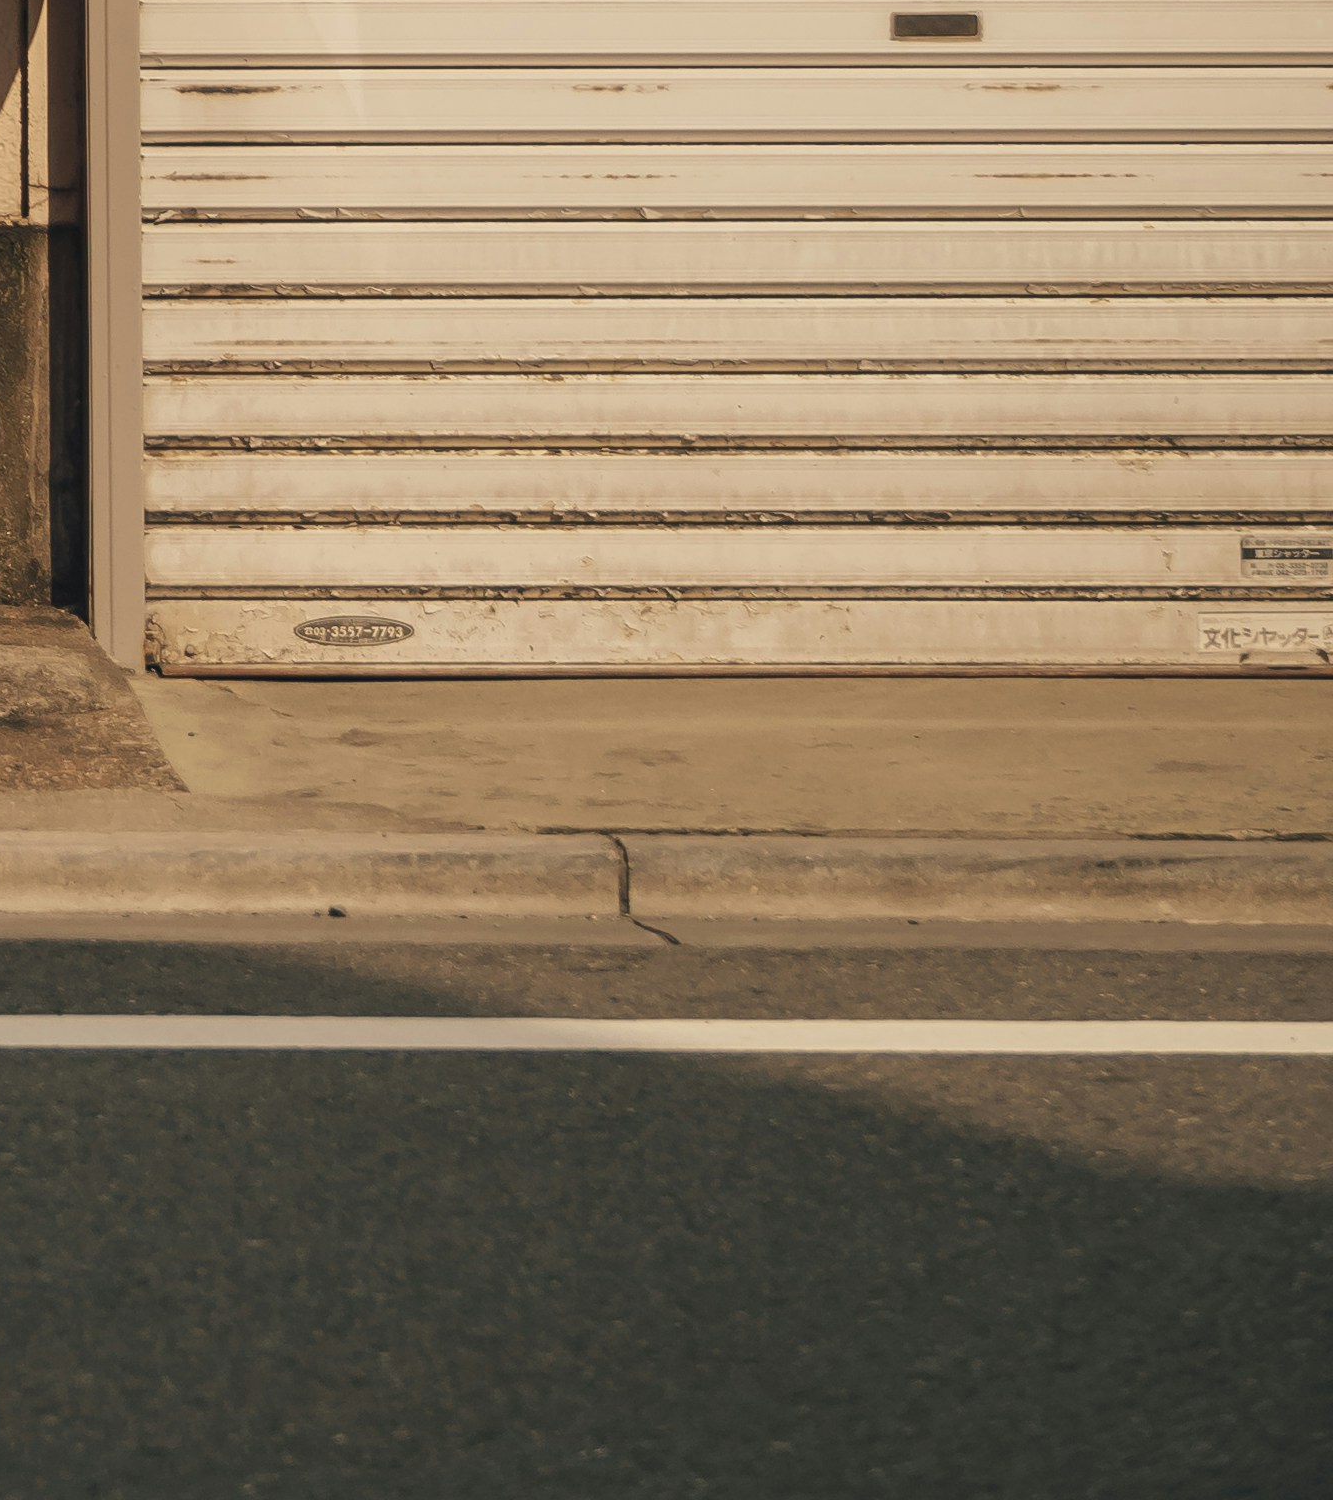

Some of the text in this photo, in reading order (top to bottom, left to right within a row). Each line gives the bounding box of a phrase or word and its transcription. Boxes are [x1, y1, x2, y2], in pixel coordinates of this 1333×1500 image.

[1203, 627, 1319, 649] 文化シャッター
